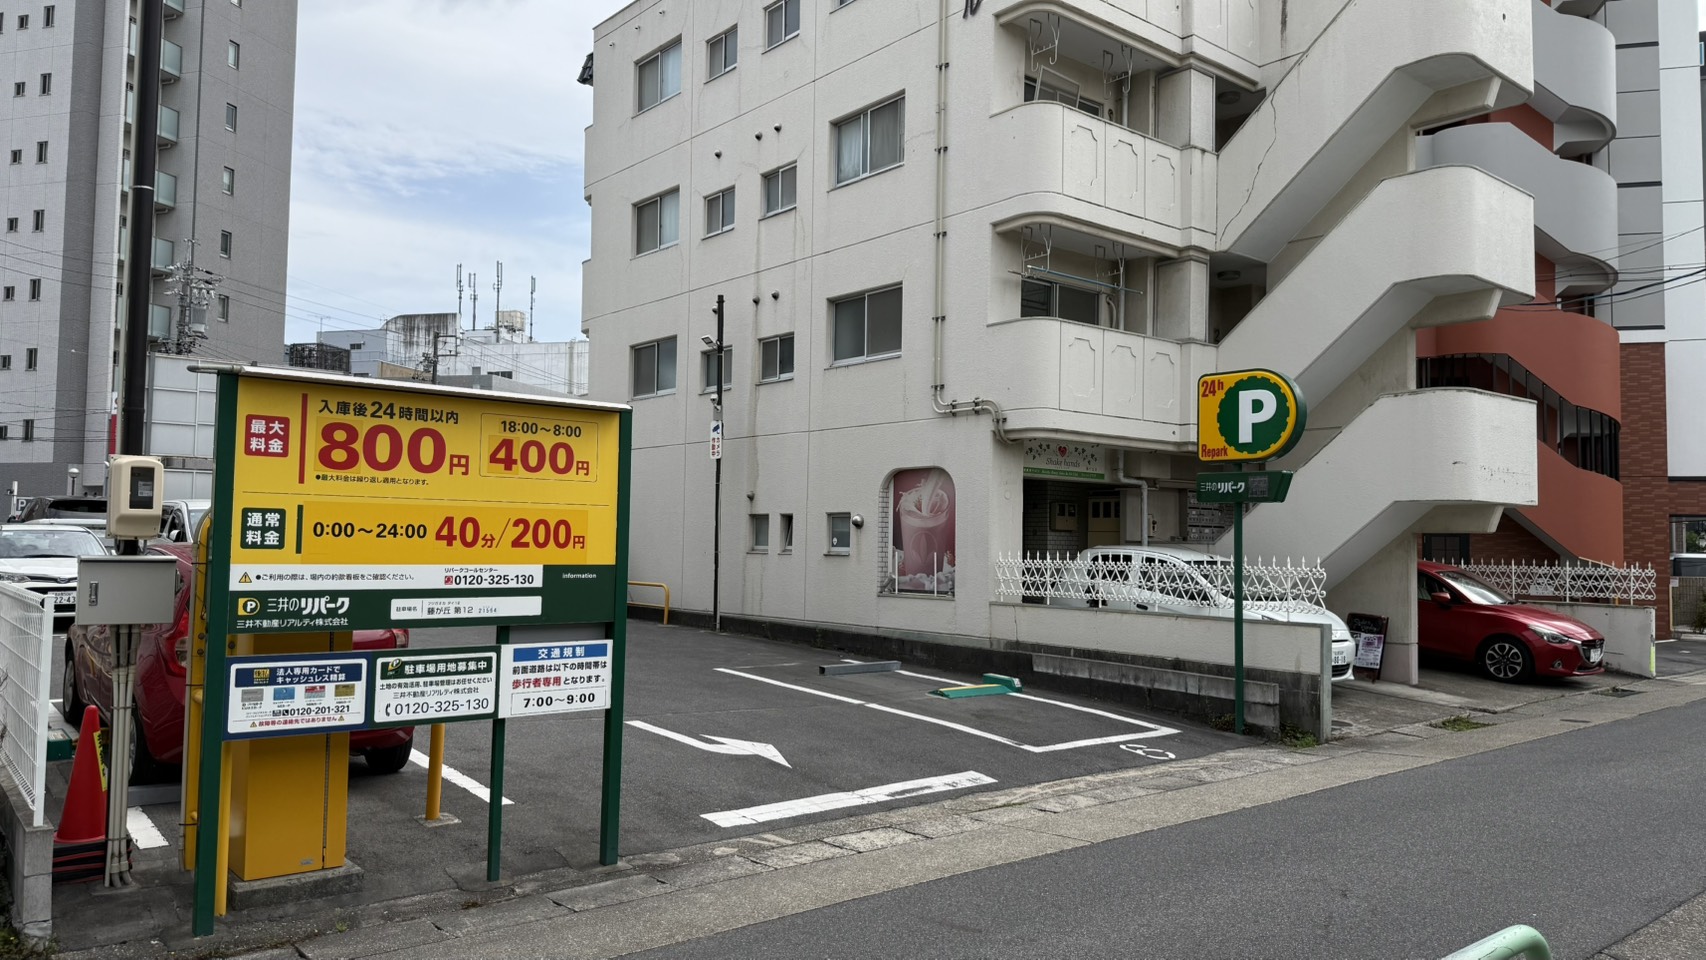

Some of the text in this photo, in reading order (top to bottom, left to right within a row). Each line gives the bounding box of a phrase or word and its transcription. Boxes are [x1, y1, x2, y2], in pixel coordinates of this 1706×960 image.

[318, 399, 459, 425] 入庫後24時間以内
[1238, 389, 1277, 444] P
[250, 418, 285, 436] 最大
[250, 437, 284, 454] 料金
[317, 421, 470, 476] 800円
[1201, 443, 1229, 459] Repark
[489, 438, 590, 476] 400円
[1200, 481, 1245, 494] 三井のリパーク
[246, 512, 281, 528] 通常
[245, 530, 280, 547] 料金
[454, 574, 535, 586] 0120-325-130
[266, 595, 350, 615] 三井のリパーク
[427, 606, 474, 615] 藤が丘 第12
[236, 617, 349, 629] 三井不動産リアルティ株式会社
[537, 646, 585, 659] 交通規制
[276, 665, 341, 676] 法人専用カードで
[404, 660, 488, 675] 駐車場用地募集中
[512, 660, 607, 675] 前面道路は以下の時間帯は
[276, 673, 346, 684] キャッシュレス精算
[393, 687, 479, 699] 三井不動産リアルティ株式会社
[394, 698, 489, 716] 0120-325-130
